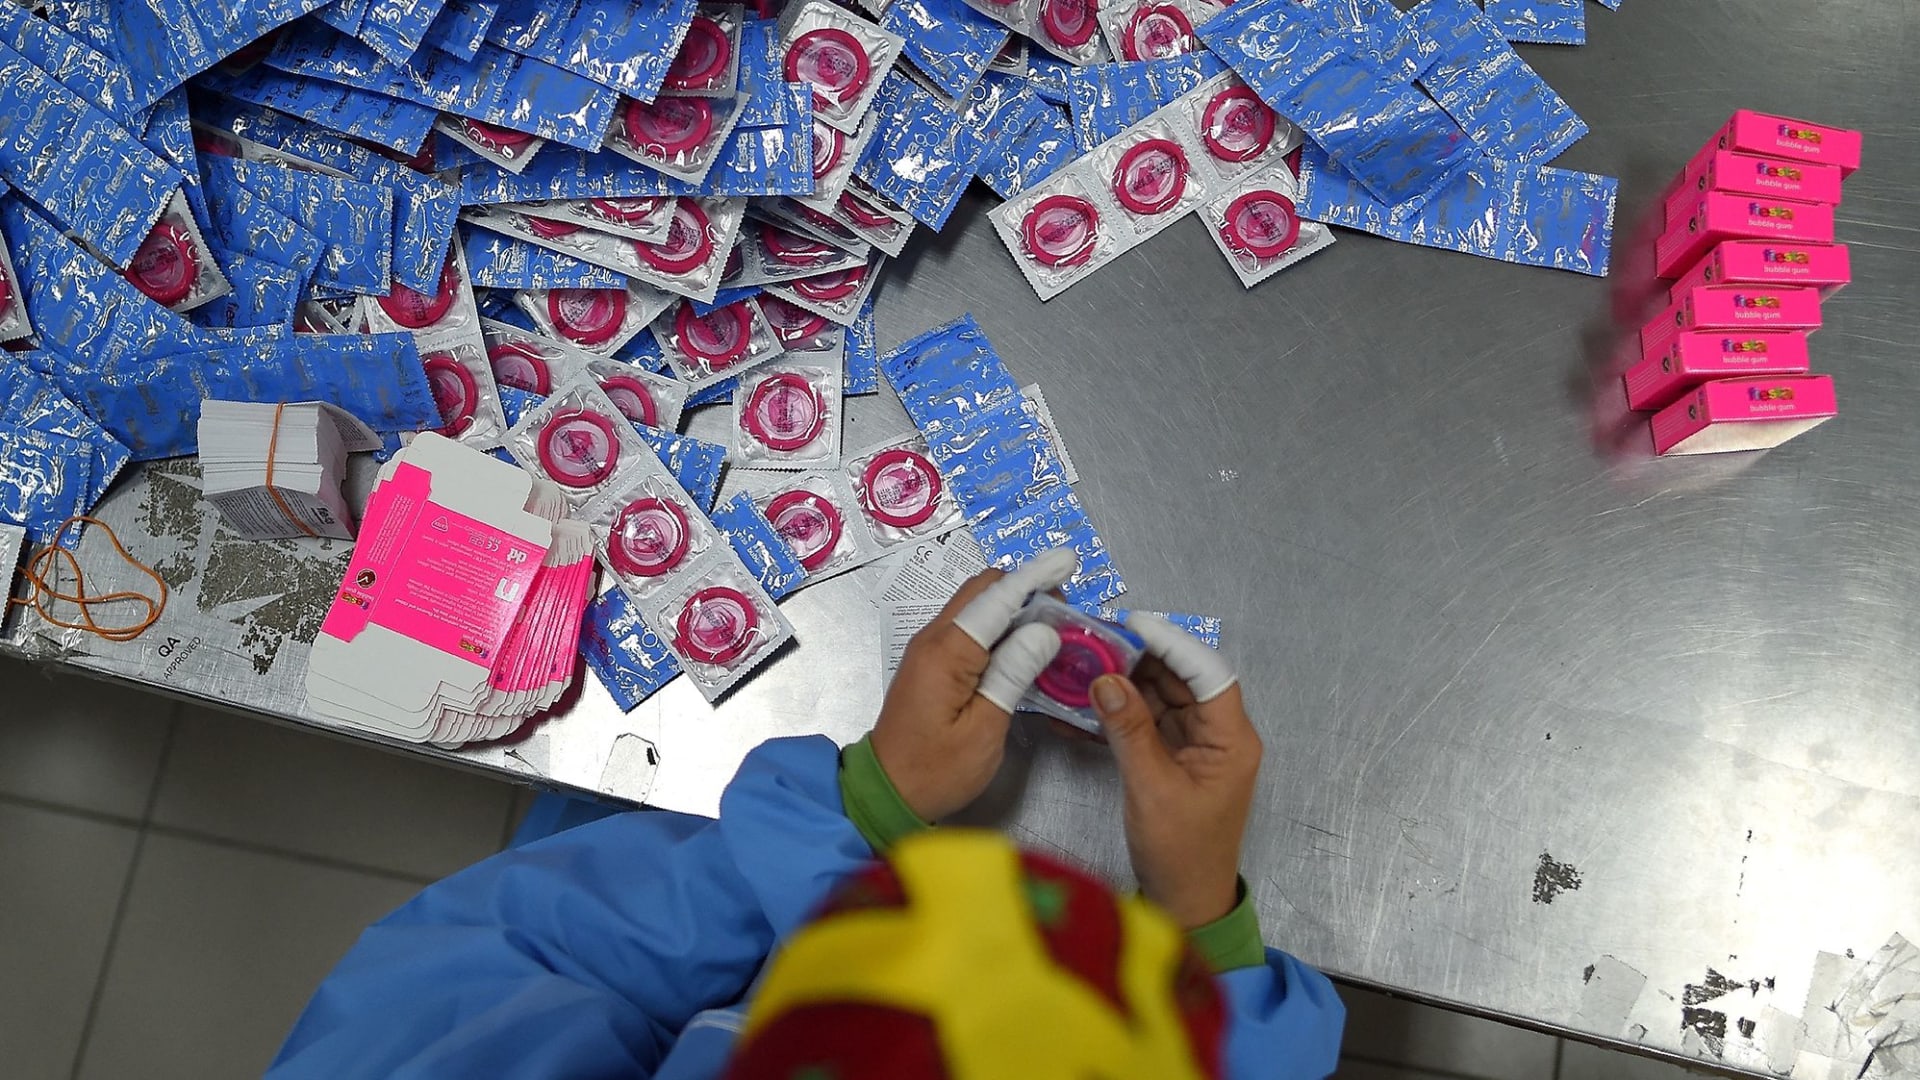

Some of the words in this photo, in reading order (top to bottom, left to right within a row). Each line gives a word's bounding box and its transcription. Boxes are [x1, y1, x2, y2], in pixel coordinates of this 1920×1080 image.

[1778, 124, 1822, 144] fiesta
[1776, 138, 1802, 150] bubble
[1803, 144, 1820, 154] gum
[1757, 162, 1803, 181] fiesta
[1756, 178, 1783, 188] bubble
[1783, 182, 1801, 191] gum
[1749, 202, 1793, 220] fiesta
[1748, 219, 1775, 229] bubble
[1775, 222, 1793, 230] gum
[1763, 249, 1809, 264] fiesta
[1764, 265, 1791, 274] bubble
[1791, 266, 1809, 275] gum
[1734, 294, 1780, 309] fiesta
[1763, 312, 1781, 320] gum
[1722, 339, 1768, 353] fiesta
[1723, 355, 1749, 363] bubble
[1750, 356, 1768, 364] gum
[1748, 387, 1795, 401] fiesta
[1750, 404, 1776, 412] bubble
[1777, 403, 1795, 412] gum
[158, 637, 181, 657] QA
[163, 636, 201, 680] APPROVED
